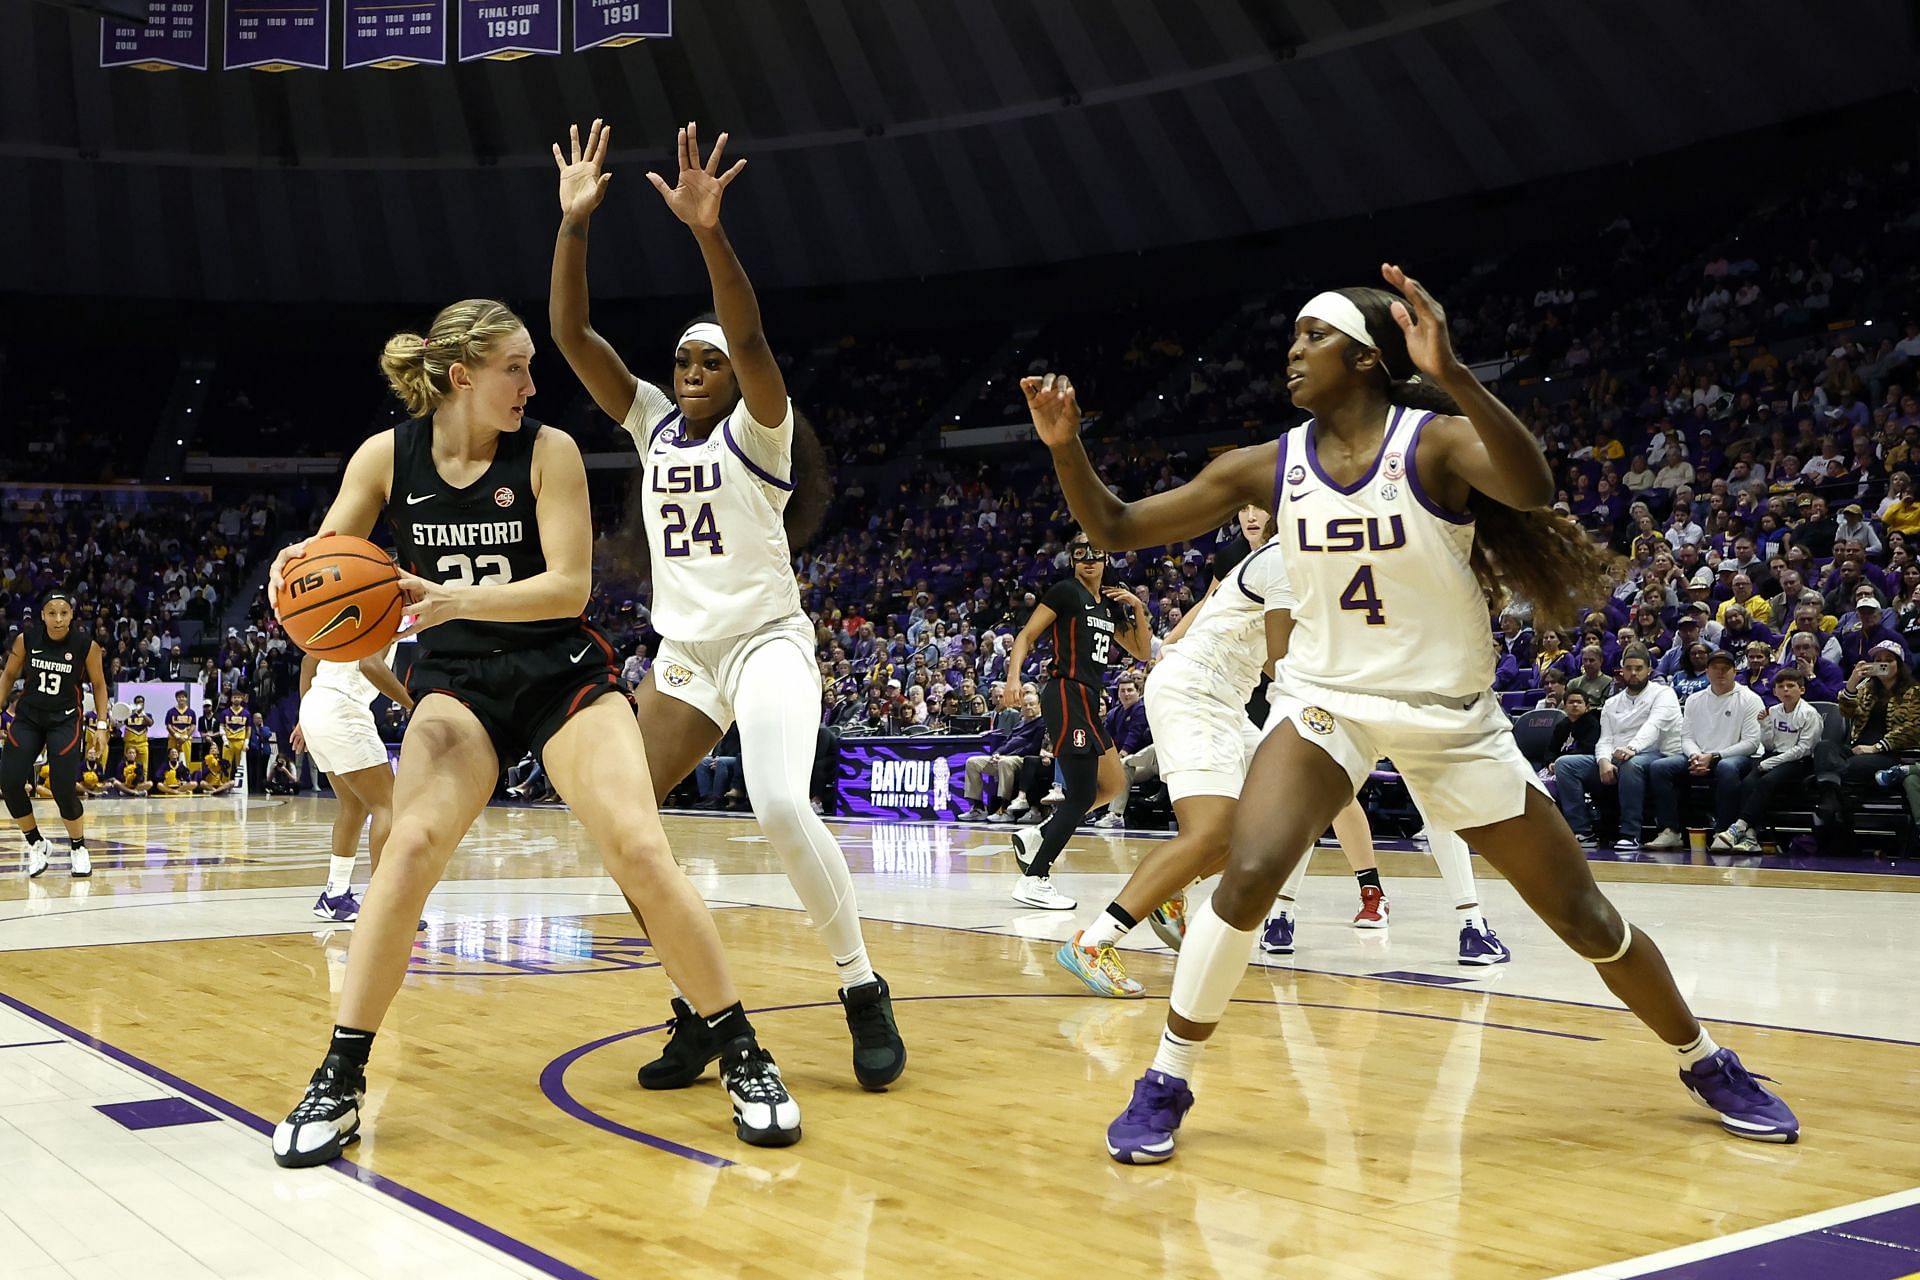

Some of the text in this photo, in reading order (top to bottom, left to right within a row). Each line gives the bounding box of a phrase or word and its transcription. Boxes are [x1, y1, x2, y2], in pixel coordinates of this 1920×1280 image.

[478, 4, 540, 19] FINAL FOUR
[603, 4, 640, 26] 1991
[487, 19, 531, 38] 1990
[652, 462, 722, 493] LSU
[412, 520, 523, 547] STANFORD
[660, 502, 724, 557] 24
[1297, 514, 1407, 552] LSU
[289, 564, 342, 599] LSU
[1339, 564, 1386, 625] 4
[1087, 615, 1115, 633] STANFORD
[1091, 631, 1110, 665] 32
[31, 657, 73, 674] STANFORD
[38, 671, 62, 695] 13
[171, 715, 192, 724] LSU
[226, 715, 246, 724] LSU
[870, 760, 931, 793] BAYOU
[870, 793, 929, 808] TRADITIONS
